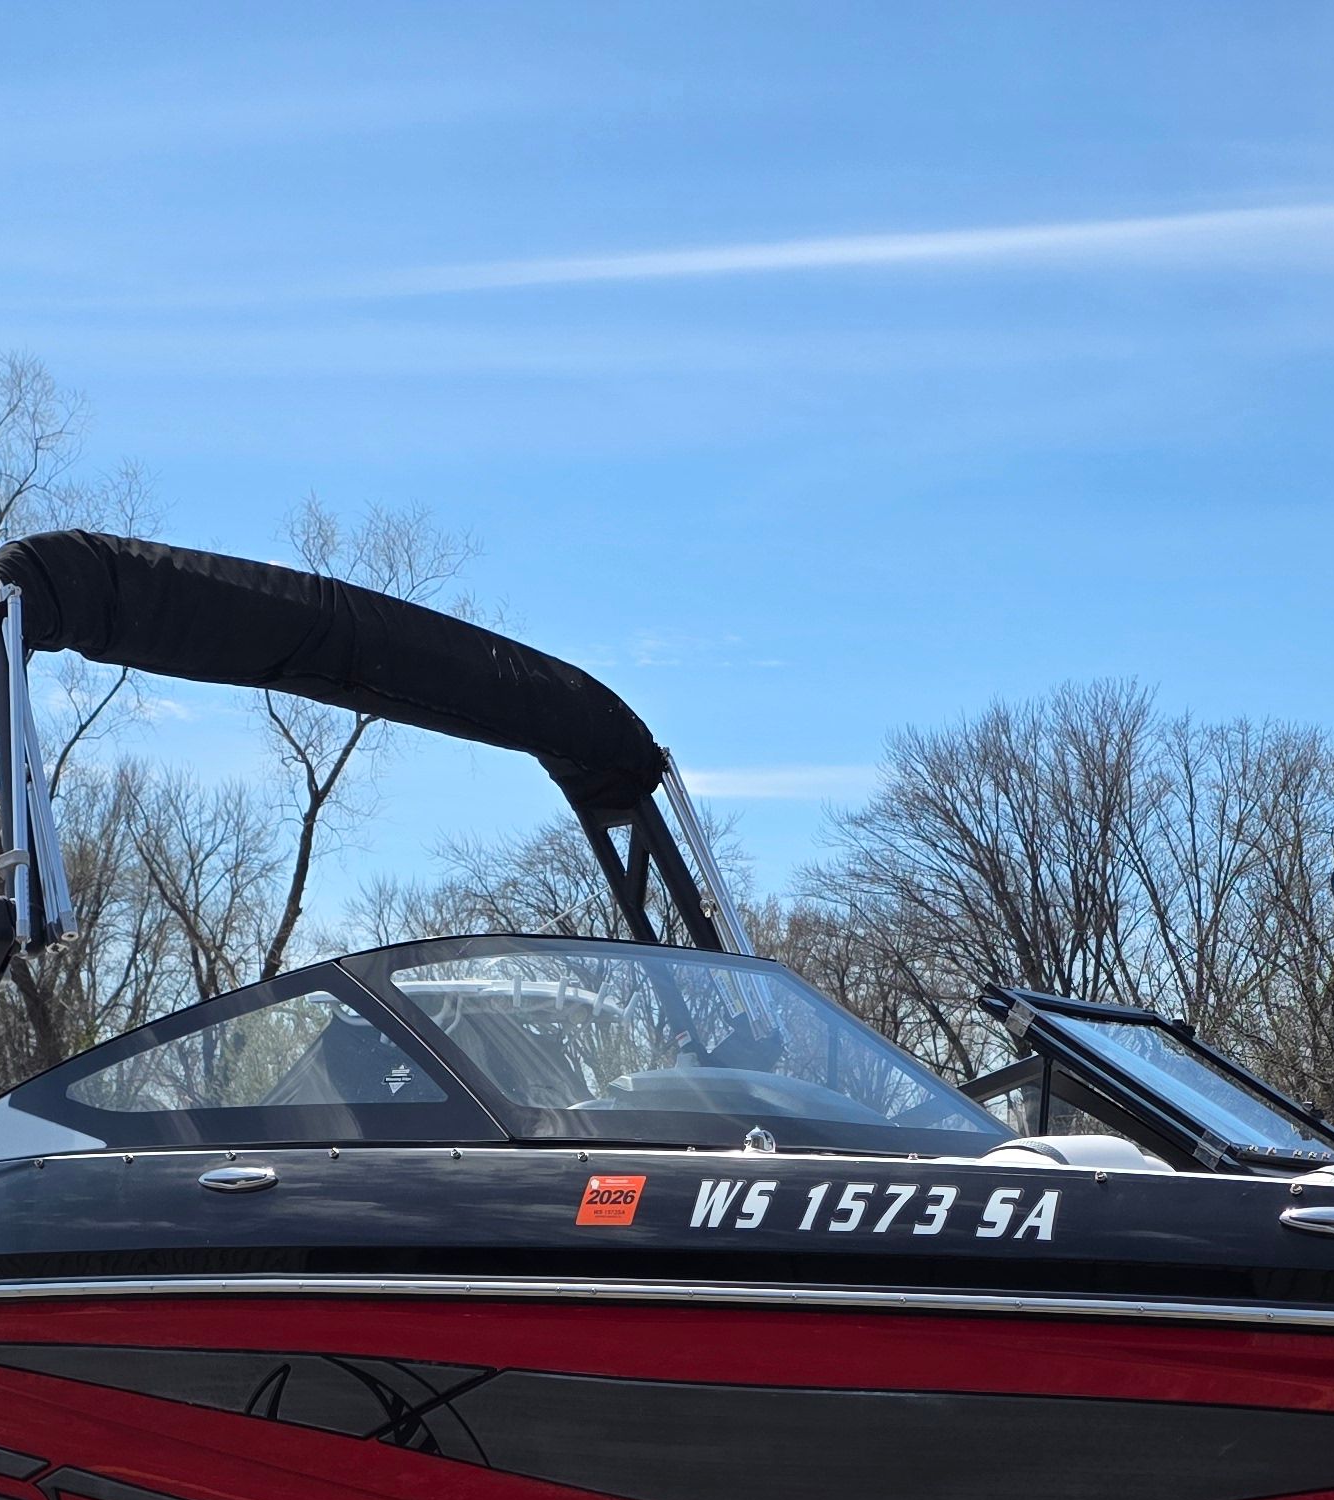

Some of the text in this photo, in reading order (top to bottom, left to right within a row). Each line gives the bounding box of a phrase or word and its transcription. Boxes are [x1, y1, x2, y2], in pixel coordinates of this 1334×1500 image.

[585, 1189, 637, 1205] 2026
[689, 1179, 1061, 1240] WS 1573 SA
